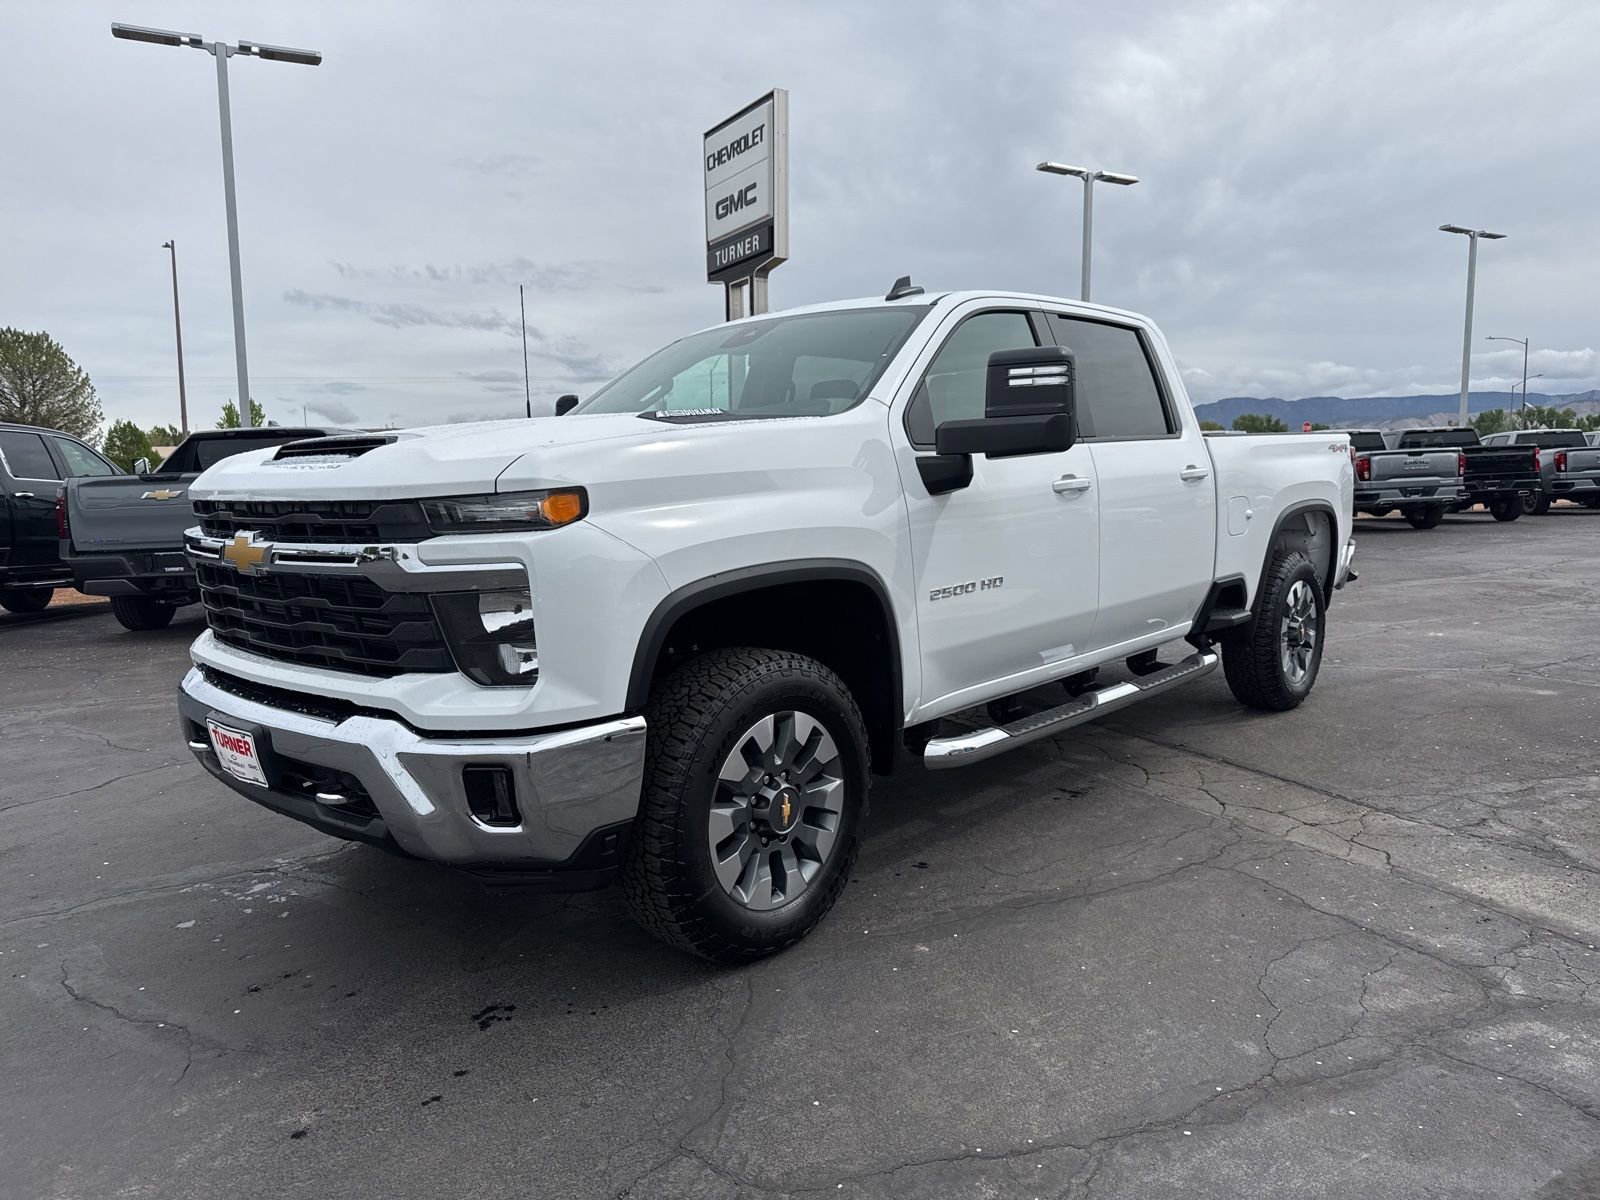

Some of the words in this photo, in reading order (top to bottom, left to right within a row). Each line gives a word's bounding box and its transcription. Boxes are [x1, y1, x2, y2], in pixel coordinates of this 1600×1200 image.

[707, 124, 765, 171] CHEVROLET
[716, 183, 757, 220] GMC
[716, 235, 759, 266] TURNER
[929, 582, 976, 601] 2500
[980, 576, 1004, 590] HD
[211, 728, 253, 757] TURNER
